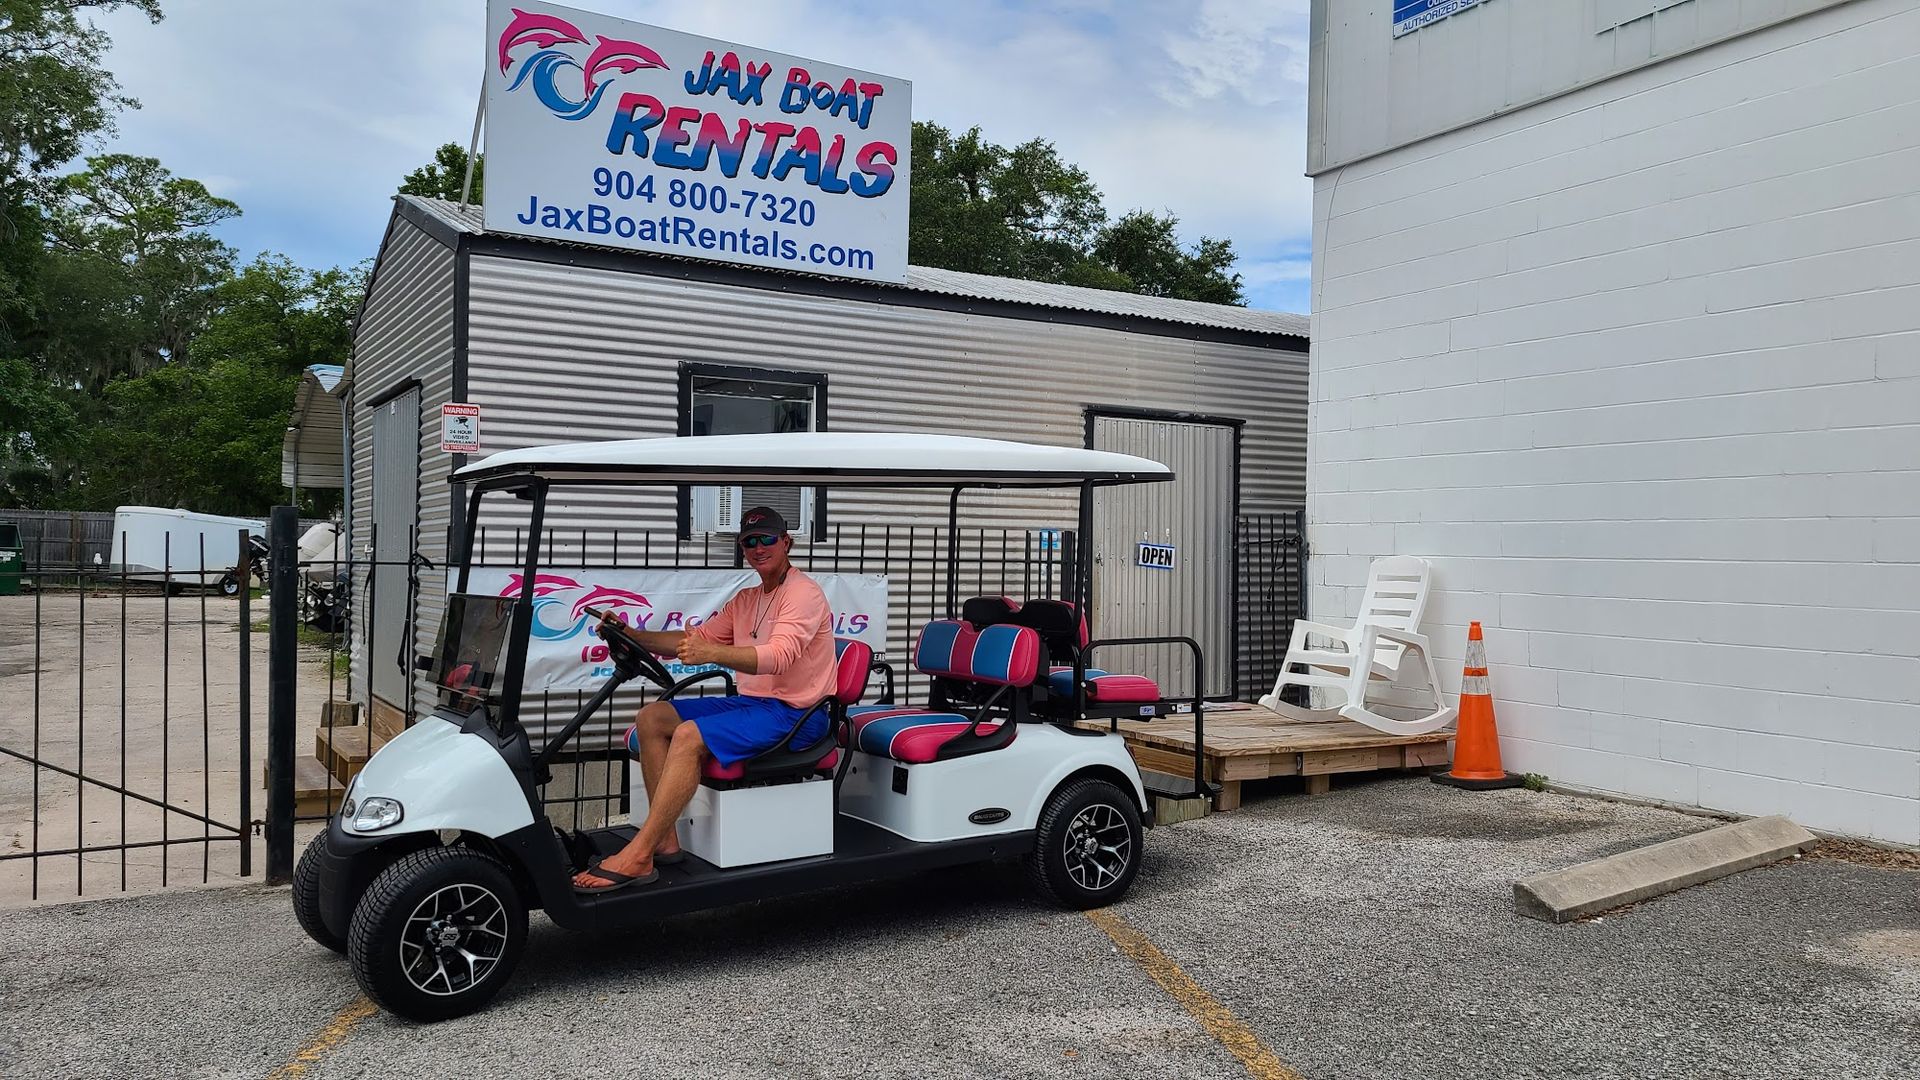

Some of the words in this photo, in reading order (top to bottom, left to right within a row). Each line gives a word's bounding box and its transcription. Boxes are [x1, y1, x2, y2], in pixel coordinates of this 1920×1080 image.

[1402, 2, 1458, 32] AUTHORIZED
[684, 50, 772, 106] JAX
[779, 66, 884, 130] BOAT
[605, 92, 897, 198] RENTALS
[593, 167, 656, 203] 904
[668, 179, 816, 227] 800-7320
[517, 196, 874, 270] JaxBoatRentals.com
[444, 407, 477, 415] WARNING
[1142, 546, 1173, 566] OPEN
